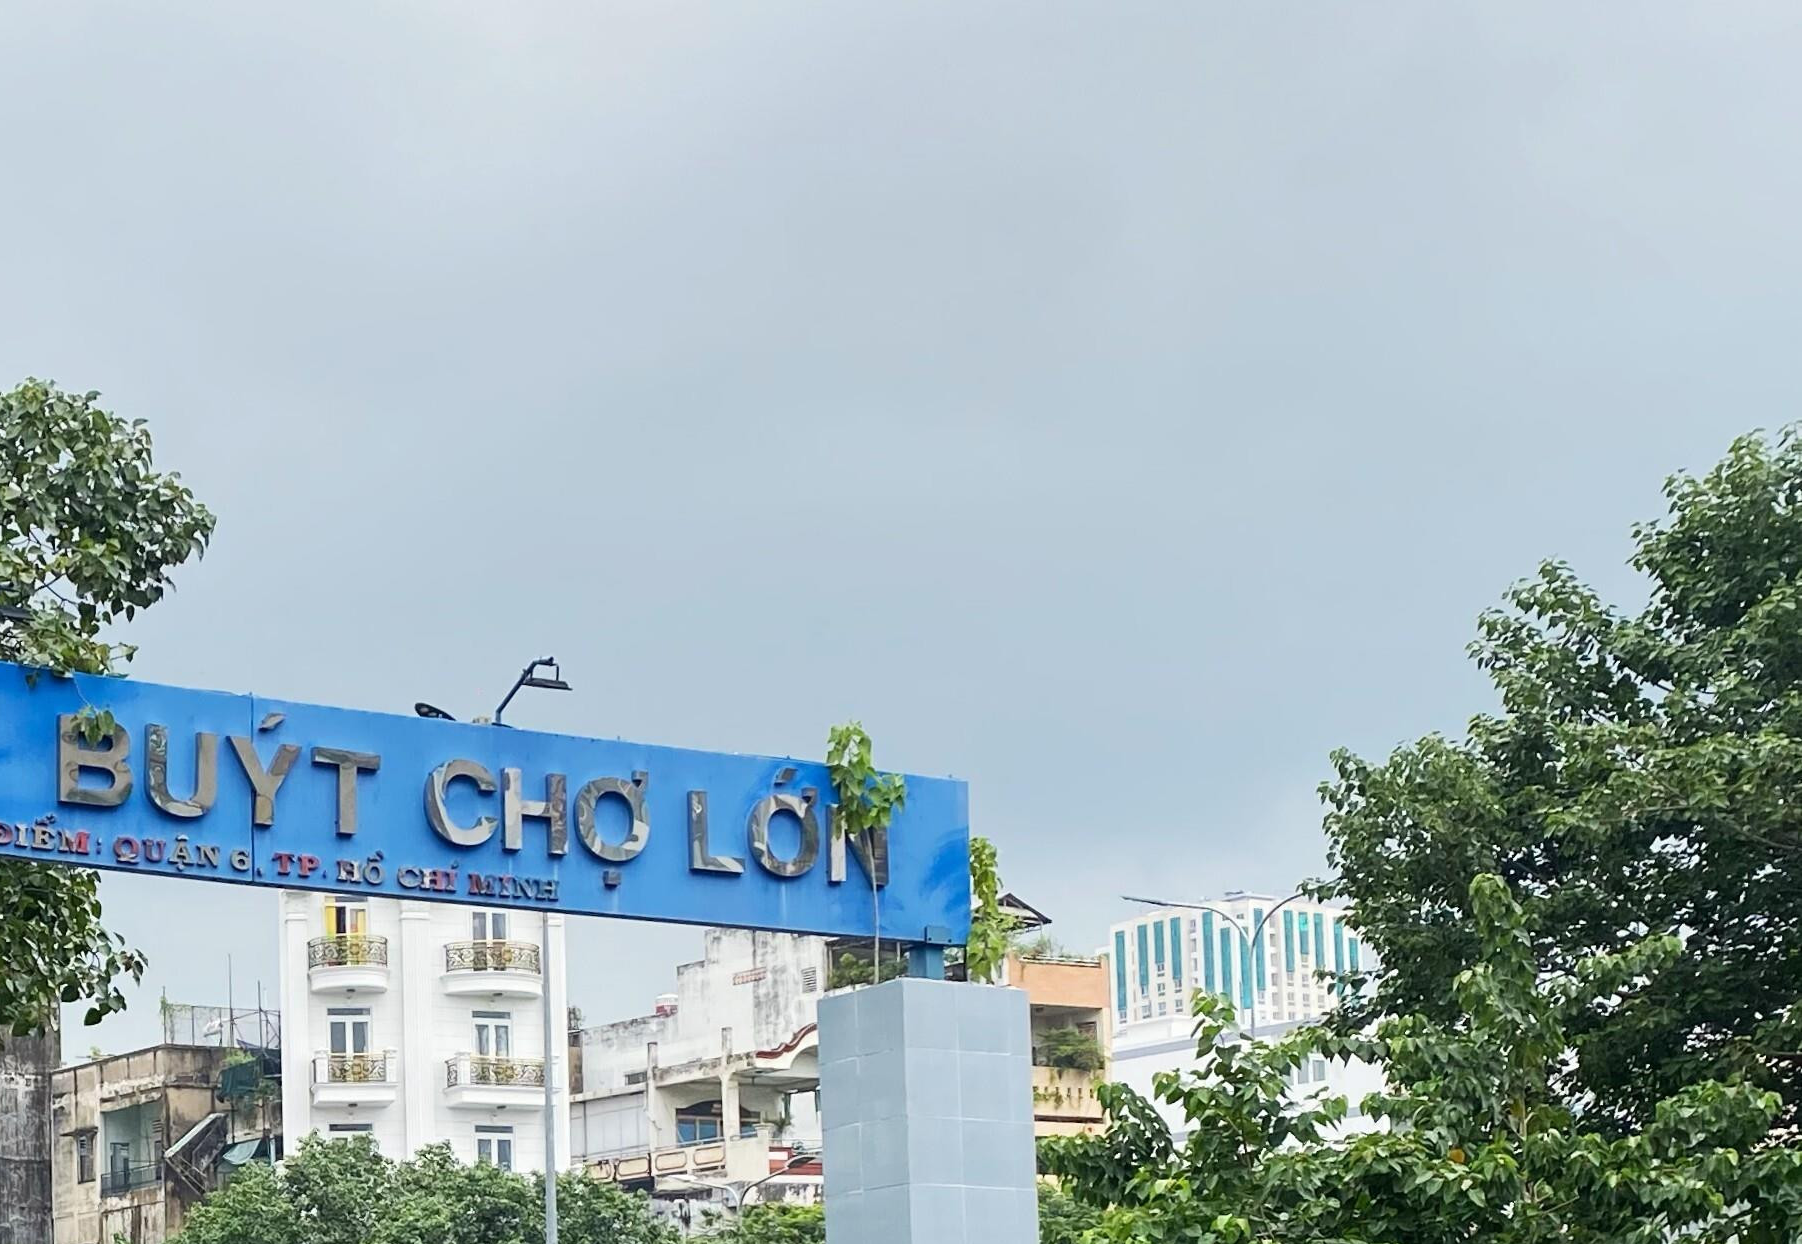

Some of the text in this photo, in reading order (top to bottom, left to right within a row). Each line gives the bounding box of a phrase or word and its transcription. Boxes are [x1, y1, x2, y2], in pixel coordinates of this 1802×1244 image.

[57, 712, 381, 838] BUÝT
[424, 757, 650, 887] CHỢ
[687, 767, 890, 886] LỚN
[113, 834, 219, 871] QUẬN
[337, 850, 386, 886] HỒ
[398, 863, 457, 892] CHÍ
[468, 872, 560, 901] MINH
